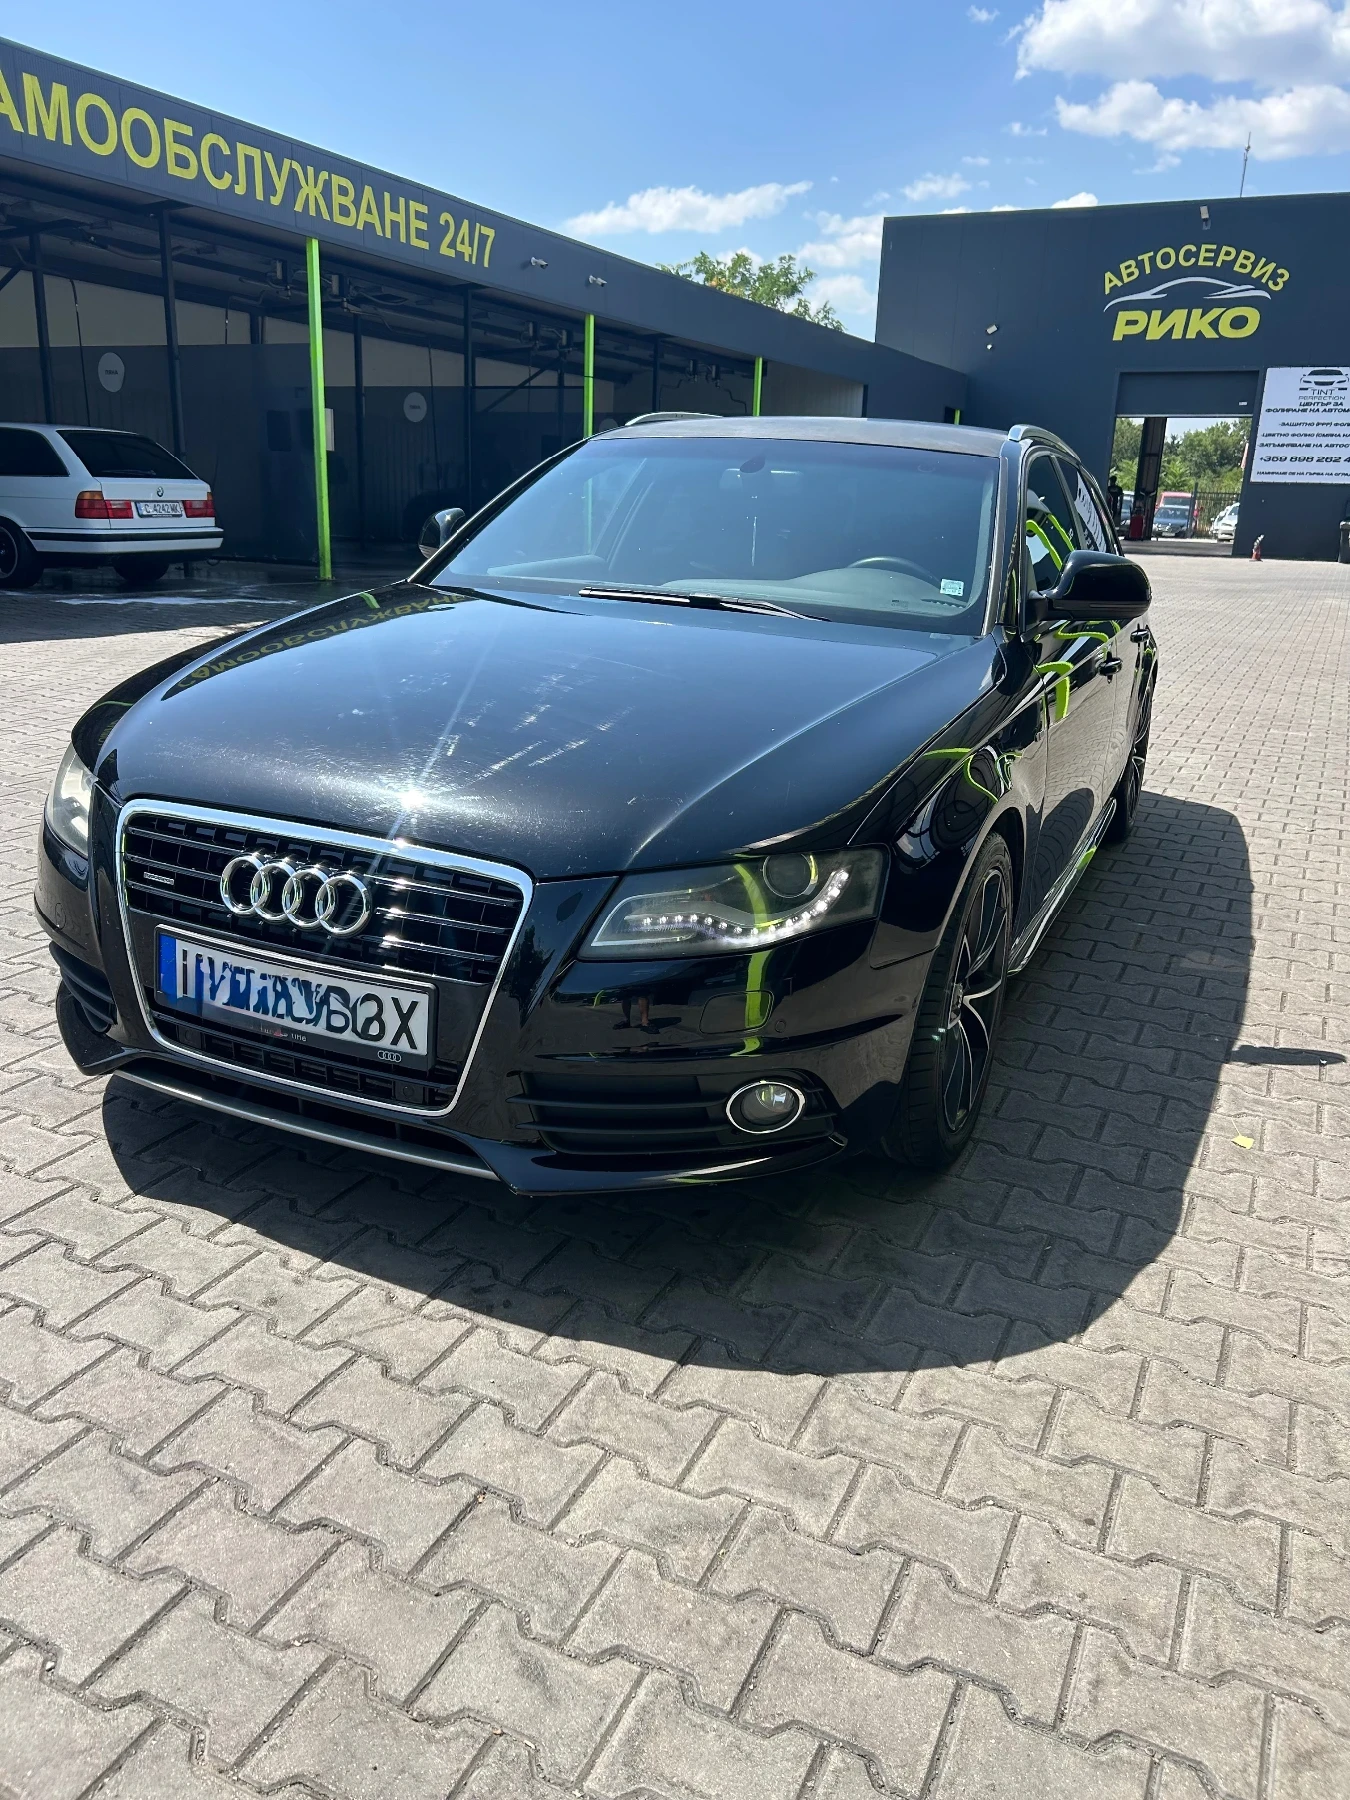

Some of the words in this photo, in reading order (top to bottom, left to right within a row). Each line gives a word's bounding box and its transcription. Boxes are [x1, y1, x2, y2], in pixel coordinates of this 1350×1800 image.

[439, 212, 496, 268] 24/7
[1104, 243, 1290, 295] АВТОСЕРВИЗ
[1112, 306, 1261, 341] РИКО
[1310, 388, 1336, 396] TINT
